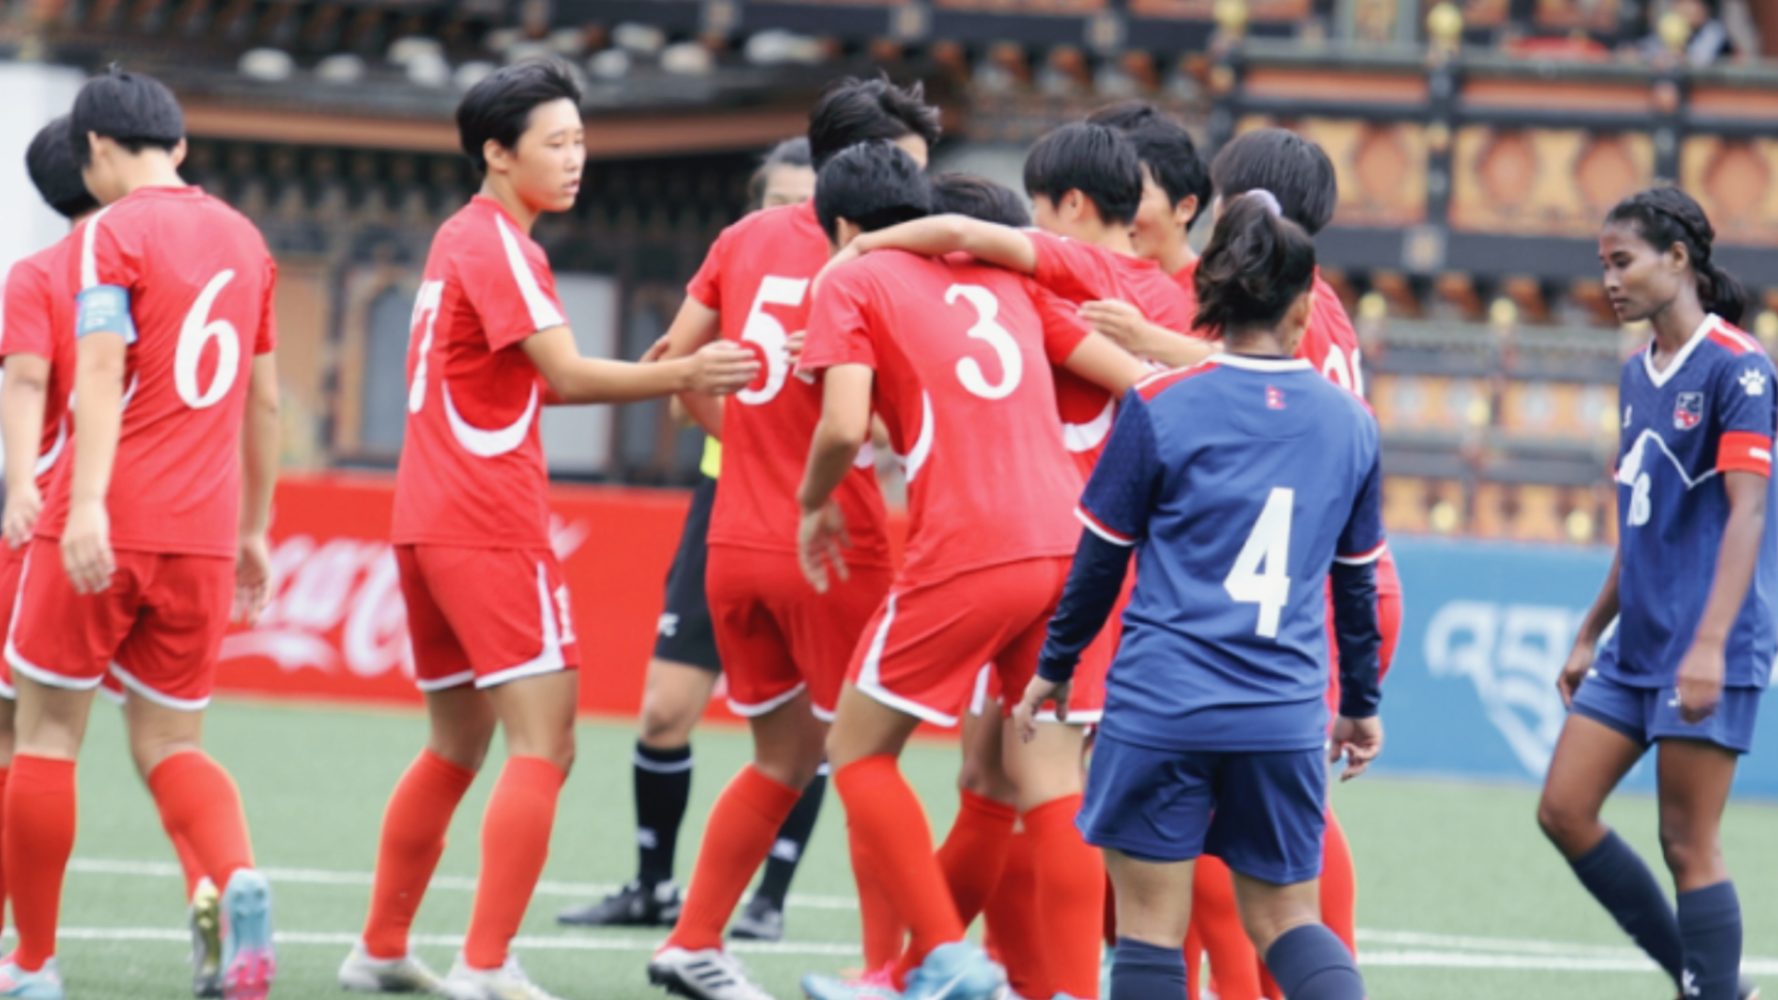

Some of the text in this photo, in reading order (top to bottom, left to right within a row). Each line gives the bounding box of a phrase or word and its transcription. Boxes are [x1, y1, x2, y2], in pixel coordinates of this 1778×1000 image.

[174, 268, 240, 410] 6
[735, 275, 809, 405] 5
[944, 283, 1023, 400] 3
[1223, 487, 1295, 639] 4
